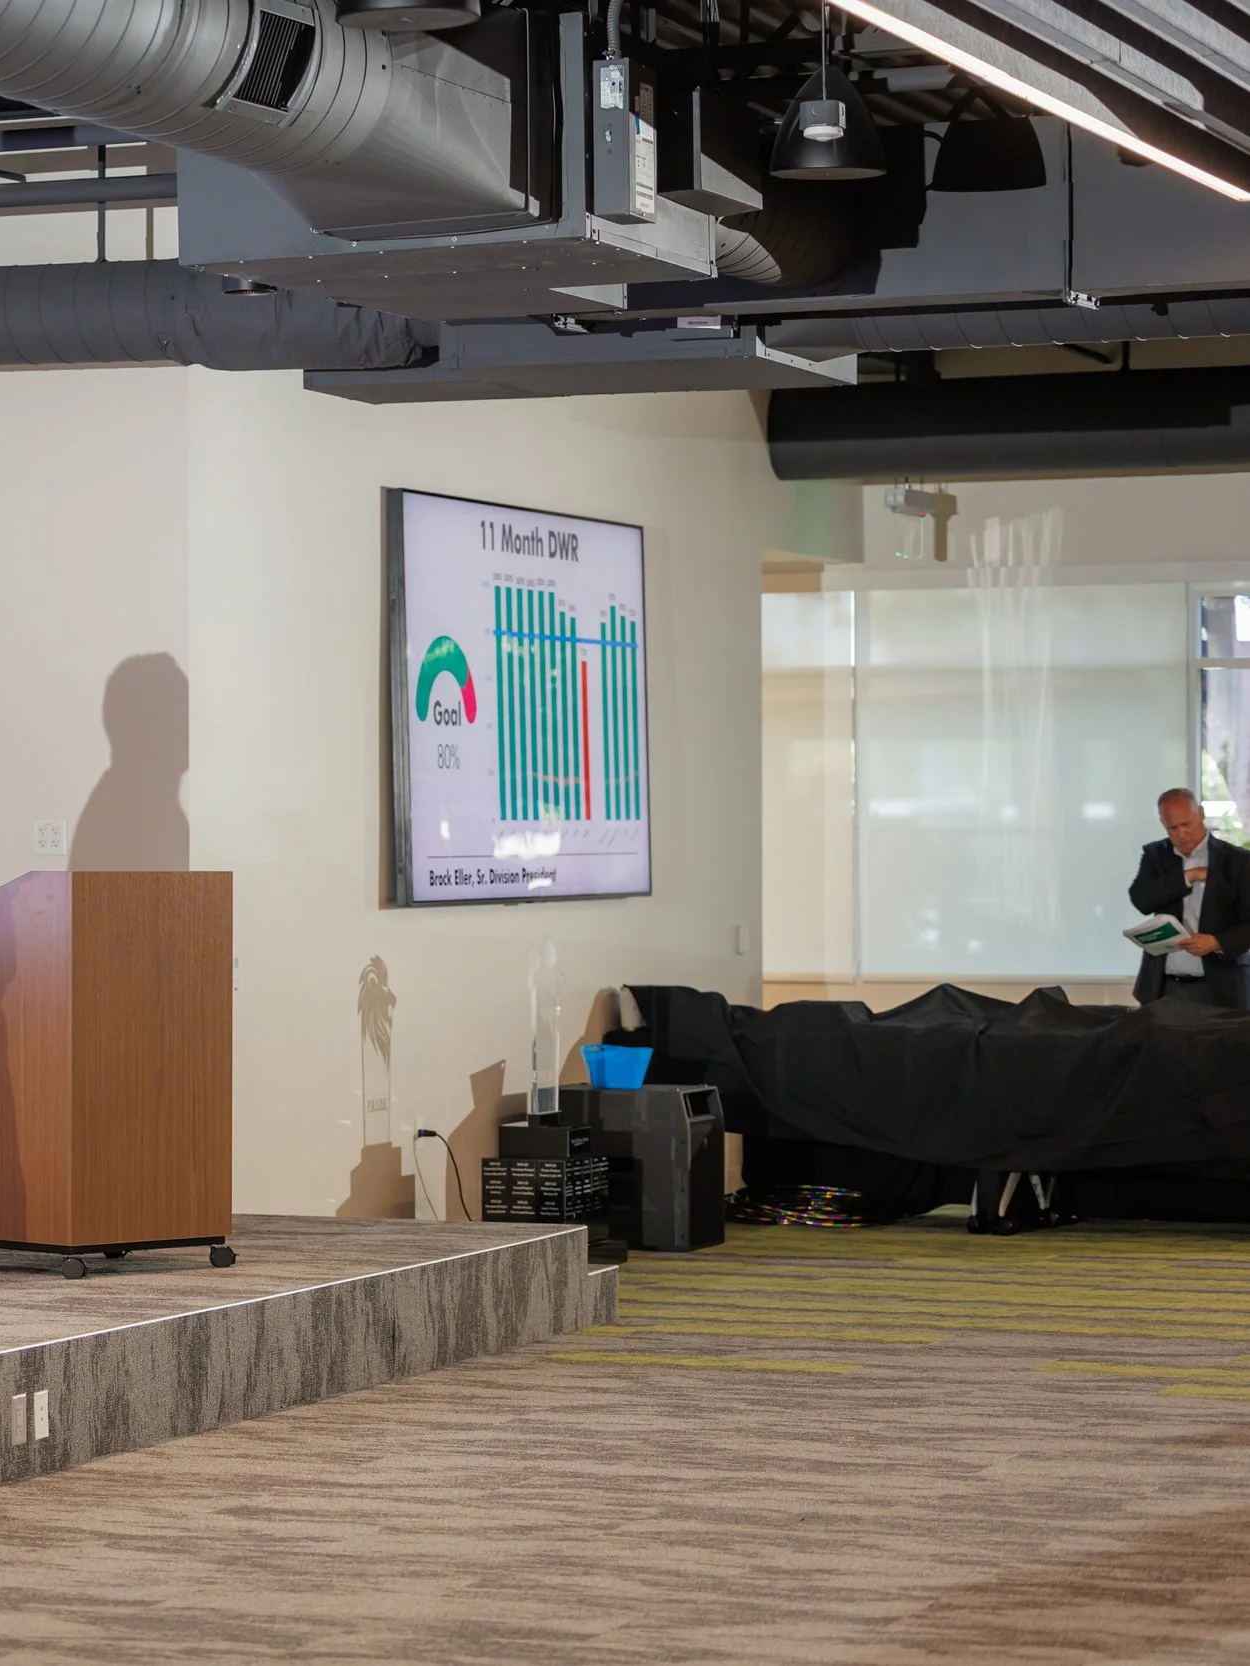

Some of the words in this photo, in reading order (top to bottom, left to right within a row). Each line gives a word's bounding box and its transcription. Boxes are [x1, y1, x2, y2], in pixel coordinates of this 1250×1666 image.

[481, 520, 495, 551] 11
[501, 522, 543, 557] Month
[548, 530, 579, 562] DWR
[433, 700, 462, 726] Goal
[437, 743, 461, 769] 80%
[429, 867, 452, 886] Brock
[454, 868, 475, 888] Eller,
[476, 868, 488, 884] Sr.
[489, 867, 520, 884] Division
